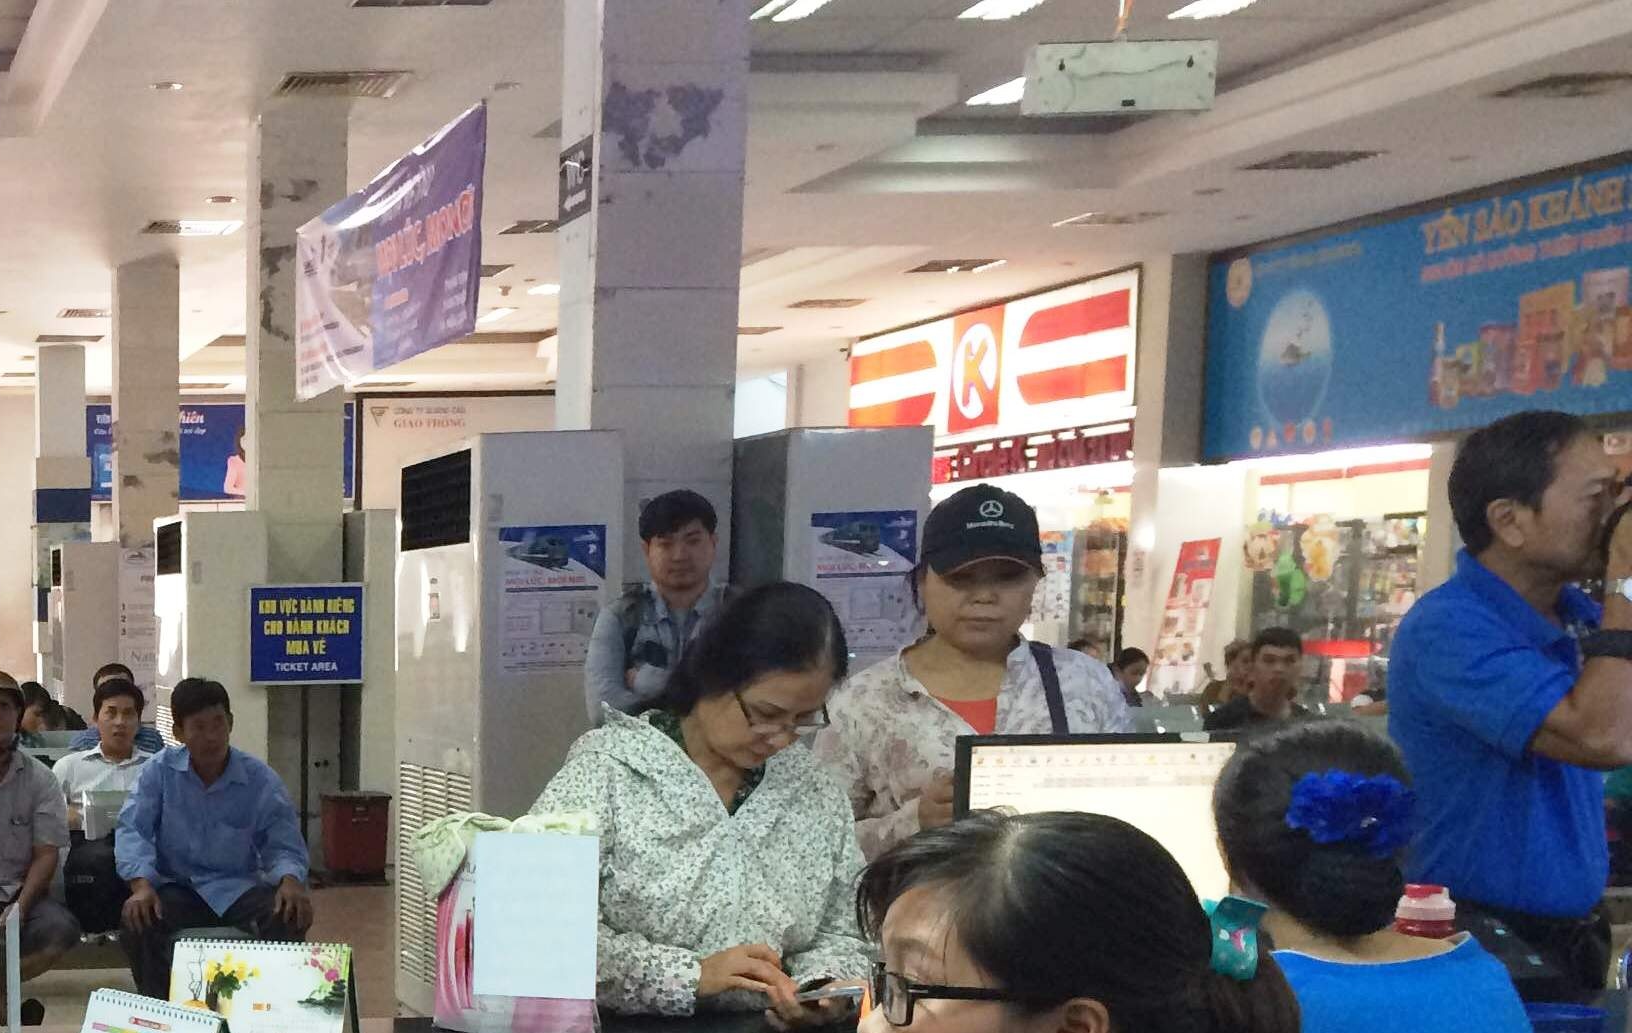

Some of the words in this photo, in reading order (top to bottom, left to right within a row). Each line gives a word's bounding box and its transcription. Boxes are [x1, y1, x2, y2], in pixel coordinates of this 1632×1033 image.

[285, 640, 310, 655] MUA
[274, 662, 309, 671] TICKET
[311, 662, 338, 671] AREA
